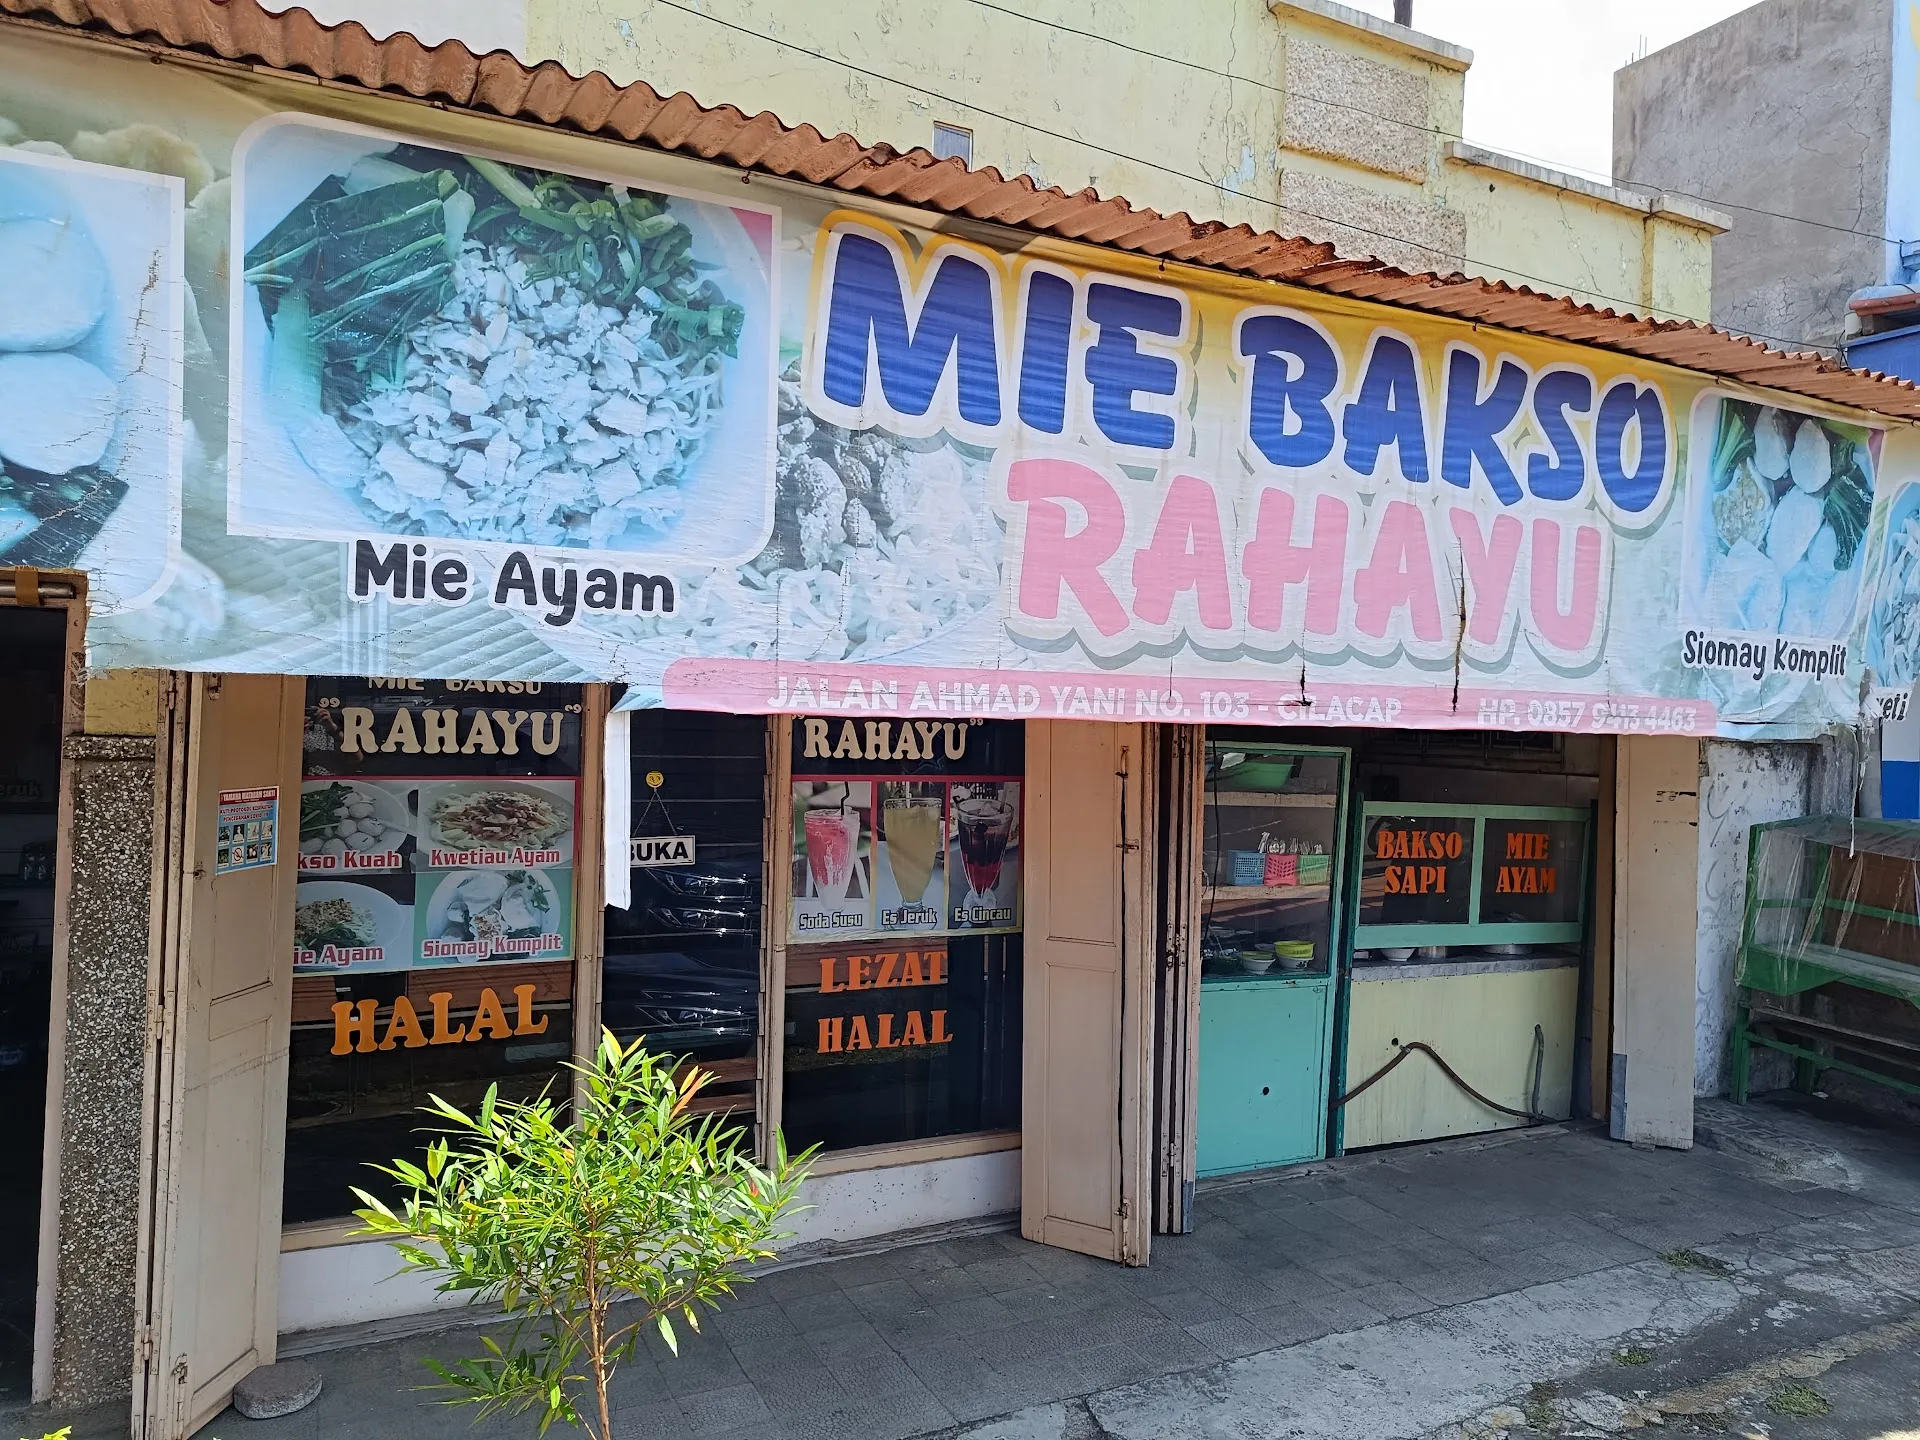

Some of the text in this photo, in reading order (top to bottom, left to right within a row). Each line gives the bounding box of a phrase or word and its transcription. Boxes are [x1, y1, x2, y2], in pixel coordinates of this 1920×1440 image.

[824, 233, 1666, 512] MIE BAKSO
[1007, 458, 1601, 650] RAHAYU
[355, 540, 674, 627] Mie Ayam
[1684, 630, 1847, 681] Siomay Komplit
[767, 676, 898, 710] JALAN
[908, 681, 1041, 714] AHMAD
[1049, 686, 1125, 715] YANI
[1135, 689, 1190, 716] NO.
[1200, 691, 1250, 718] 103
[1277, 693, 1403, 722] CILACAP
[1478, 698, 1520, 726] HP.
[1527, 700, 1585, 728] 0857
[1644, 705, 1696, 732] 4463
[431, 848, 560, 867] Kwetiau Ayam
[1376, 830, 1463, 859] BAKSO
[1506, 832, 1549, 860] MIE
[344, 851, 399, 868] Kuah
[1384, 865, 1446, 894] SAPI
[1496, 866, 1557, 893] AYAM
[800, 912, 862, 930] Soda Susu
[882, 908, 937, 925] Es Jeruk
[954, 906, 1011, 922] Es Cincau
[322, 945, 383, 966] Ayam
[424, 934, 561, 957] Siomay Komplit
[819, 951, 948, 993] LEZAT
[331, 984, 548, 1055] HALAL
[817, 1009, 953, 1053] HALAL
